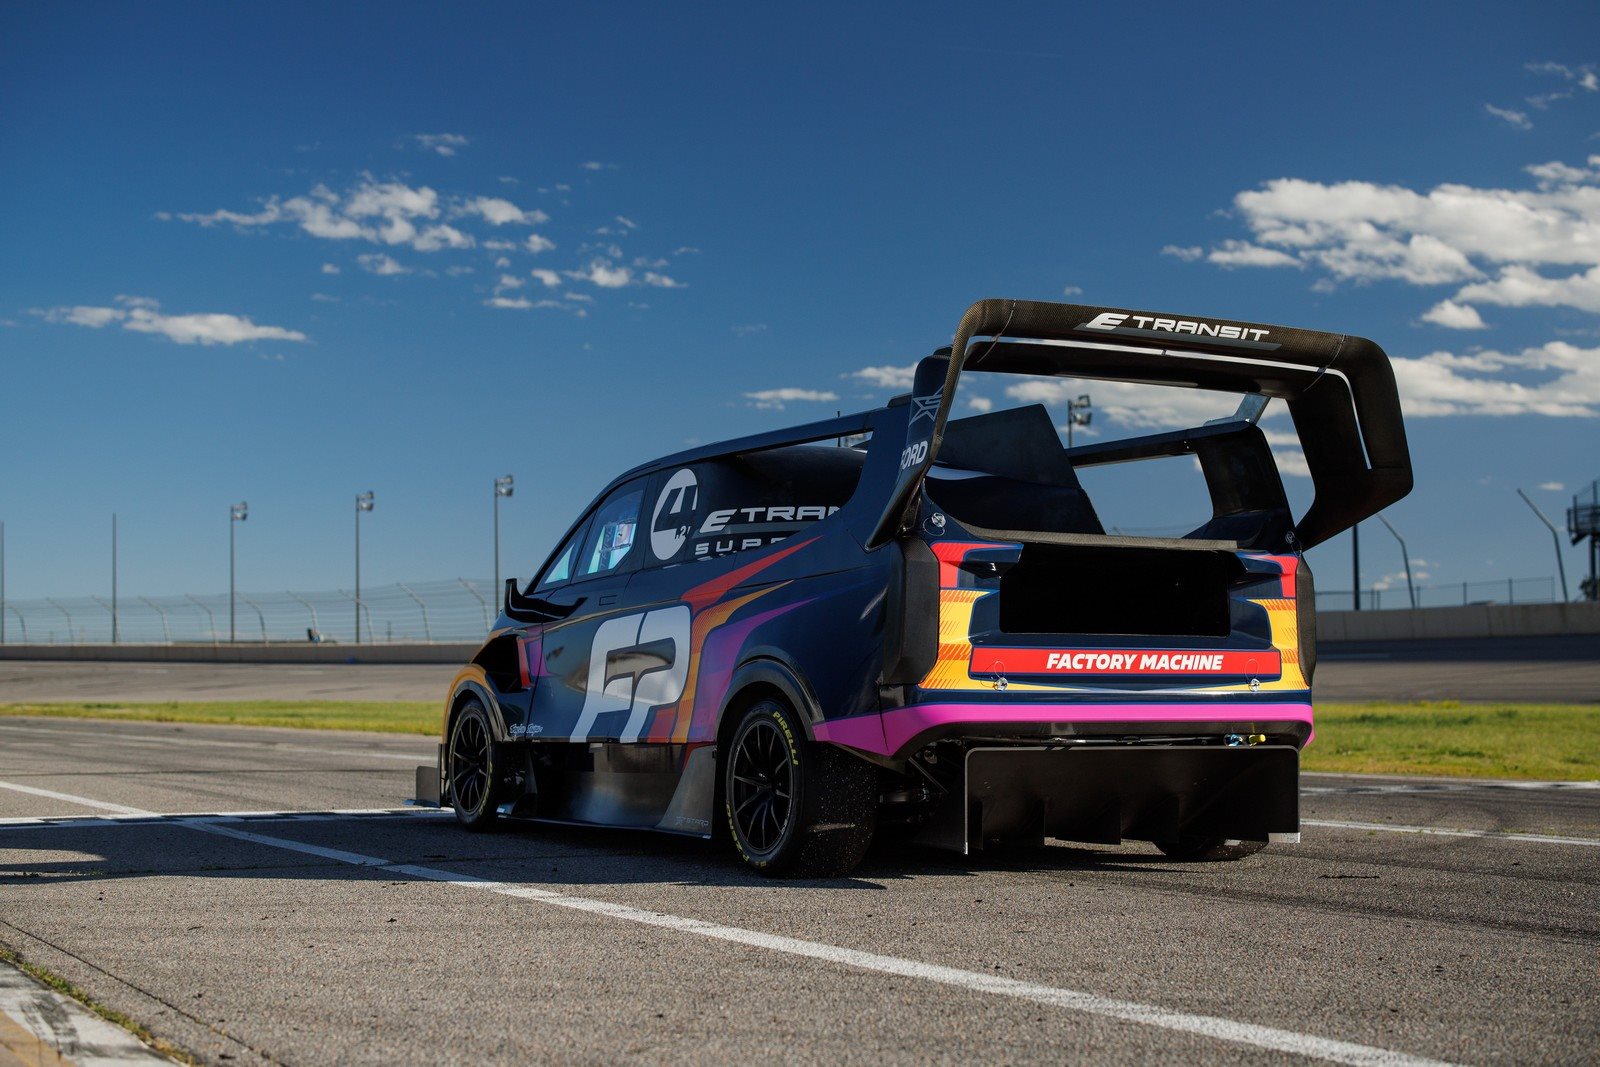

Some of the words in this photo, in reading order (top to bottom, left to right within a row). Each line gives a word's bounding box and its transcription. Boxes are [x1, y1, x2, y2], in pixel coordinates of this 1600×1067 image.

[694, 536, 788, 556] SUP
[1046, 653, 1138, 670] FACTORY
[1139, 654, 1224, 671] MACHINE
[772, 711, 799, 766] PIRELLI
